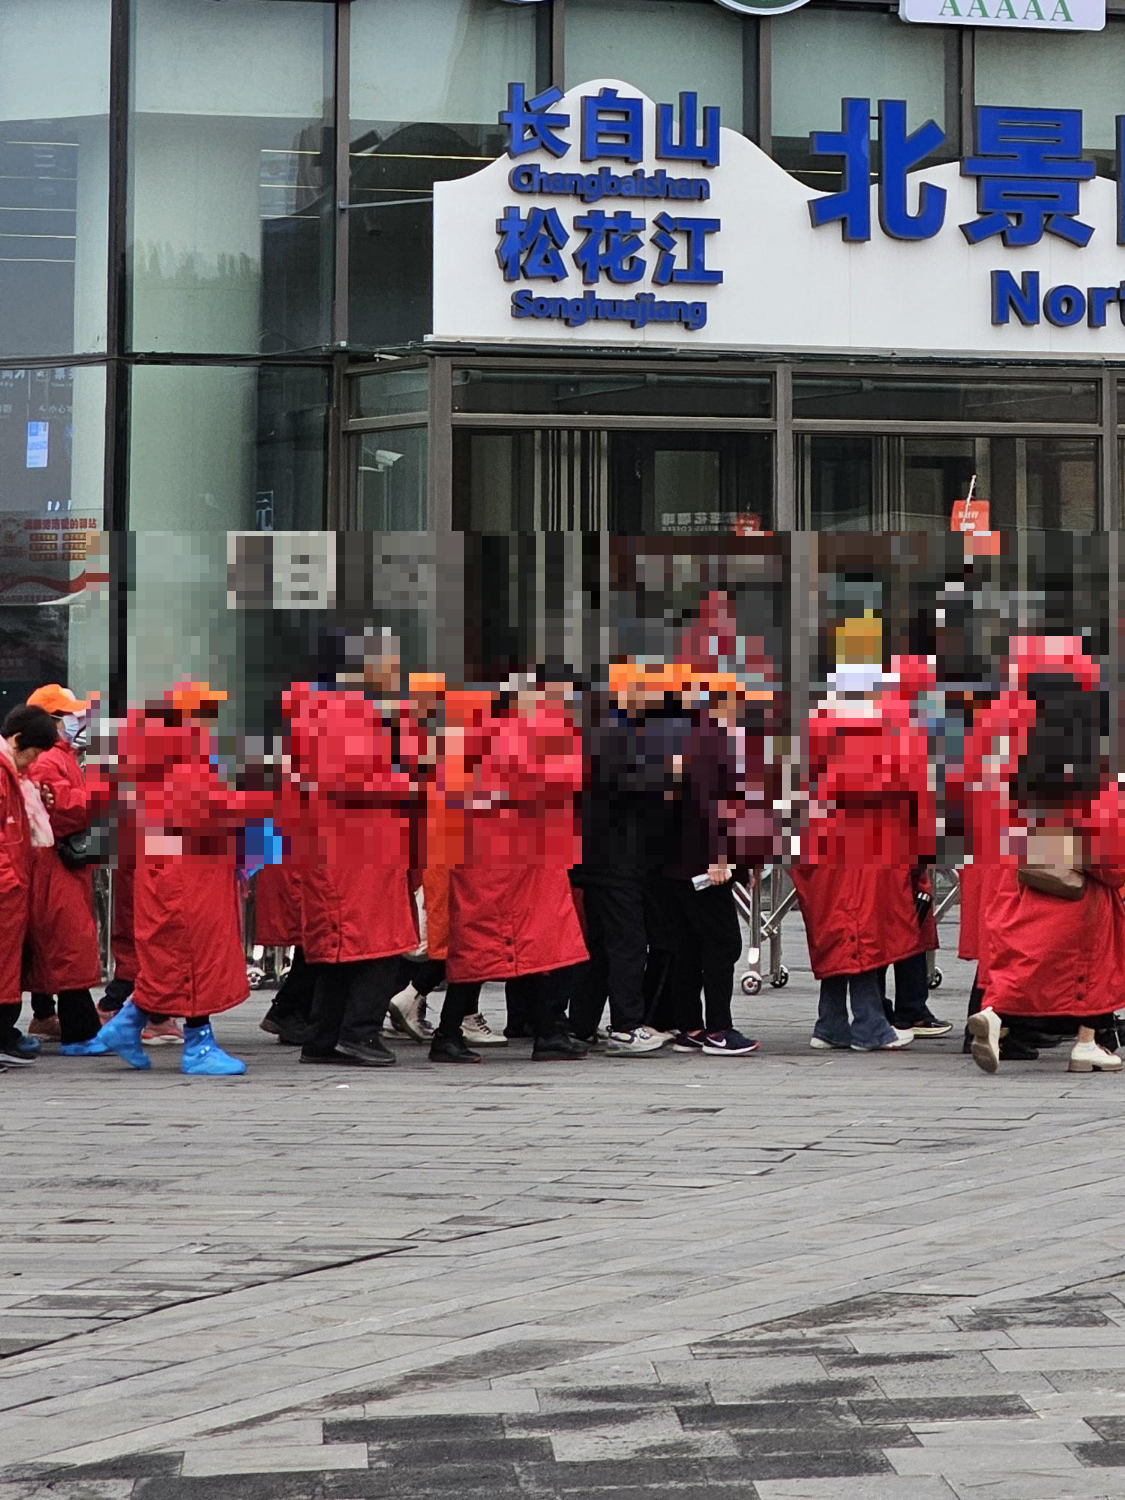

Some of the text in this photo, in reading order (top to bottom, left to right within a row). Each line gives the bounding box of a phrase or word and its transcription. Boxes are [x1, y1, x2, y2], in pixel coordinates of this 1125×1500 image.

[501, 82, 720, 167] 长白山
[508, 164, 710, 202] Changbaishan
[495, 205, 723, 286] 松花江
[511, 288, 707, 331] Songhuajiang
